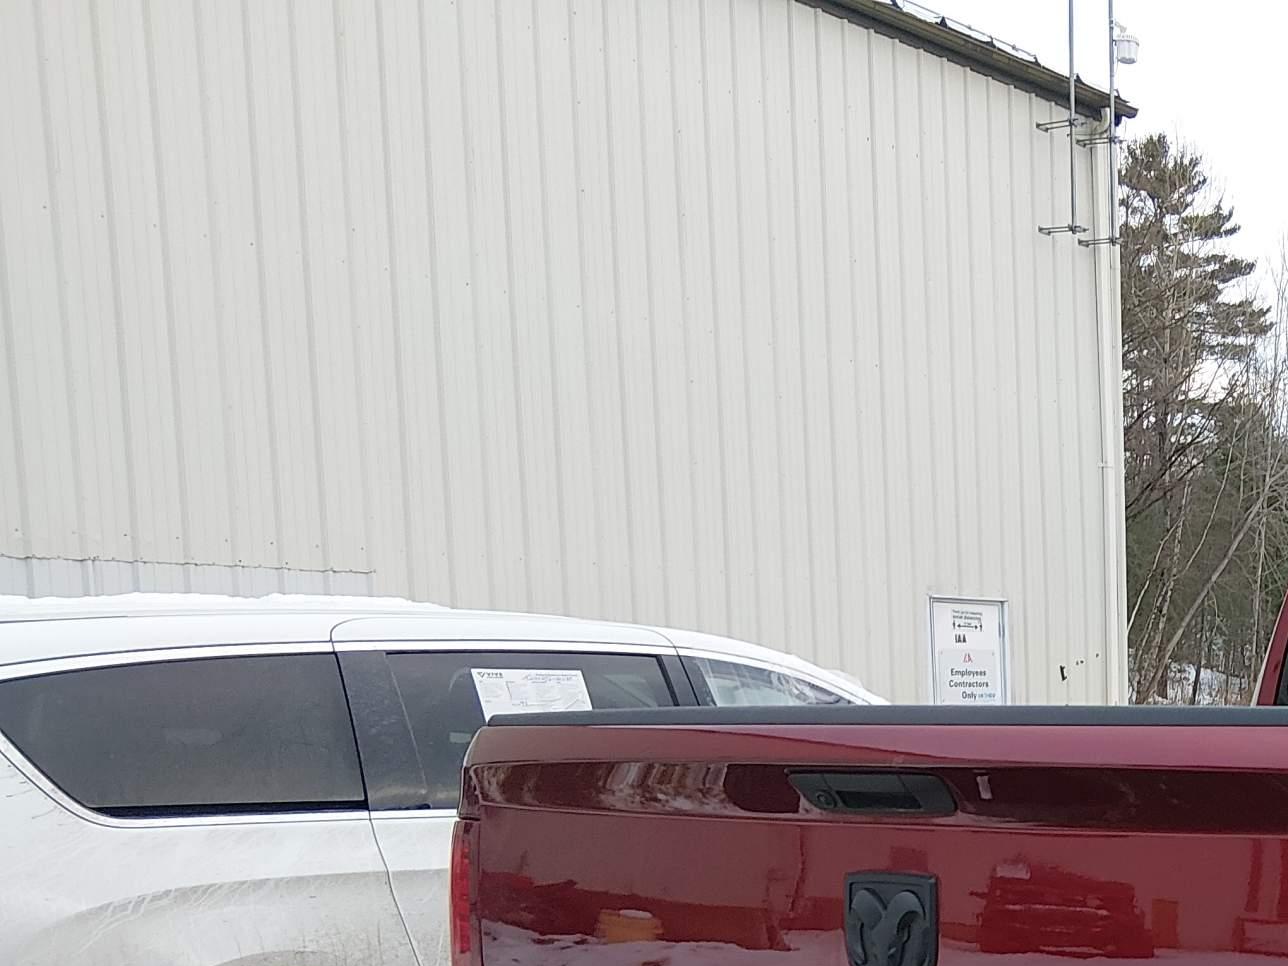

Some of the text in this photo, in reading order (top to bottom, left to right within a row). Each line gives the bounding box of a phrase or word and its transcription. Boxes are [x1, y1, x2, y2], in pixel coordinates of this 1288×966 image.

[955, 633, 967, 644] IAA
[951, 668, 987, 677] Employees
[948, 680, 989, 689] Contractors
[961, 691, 977, 701] Only
